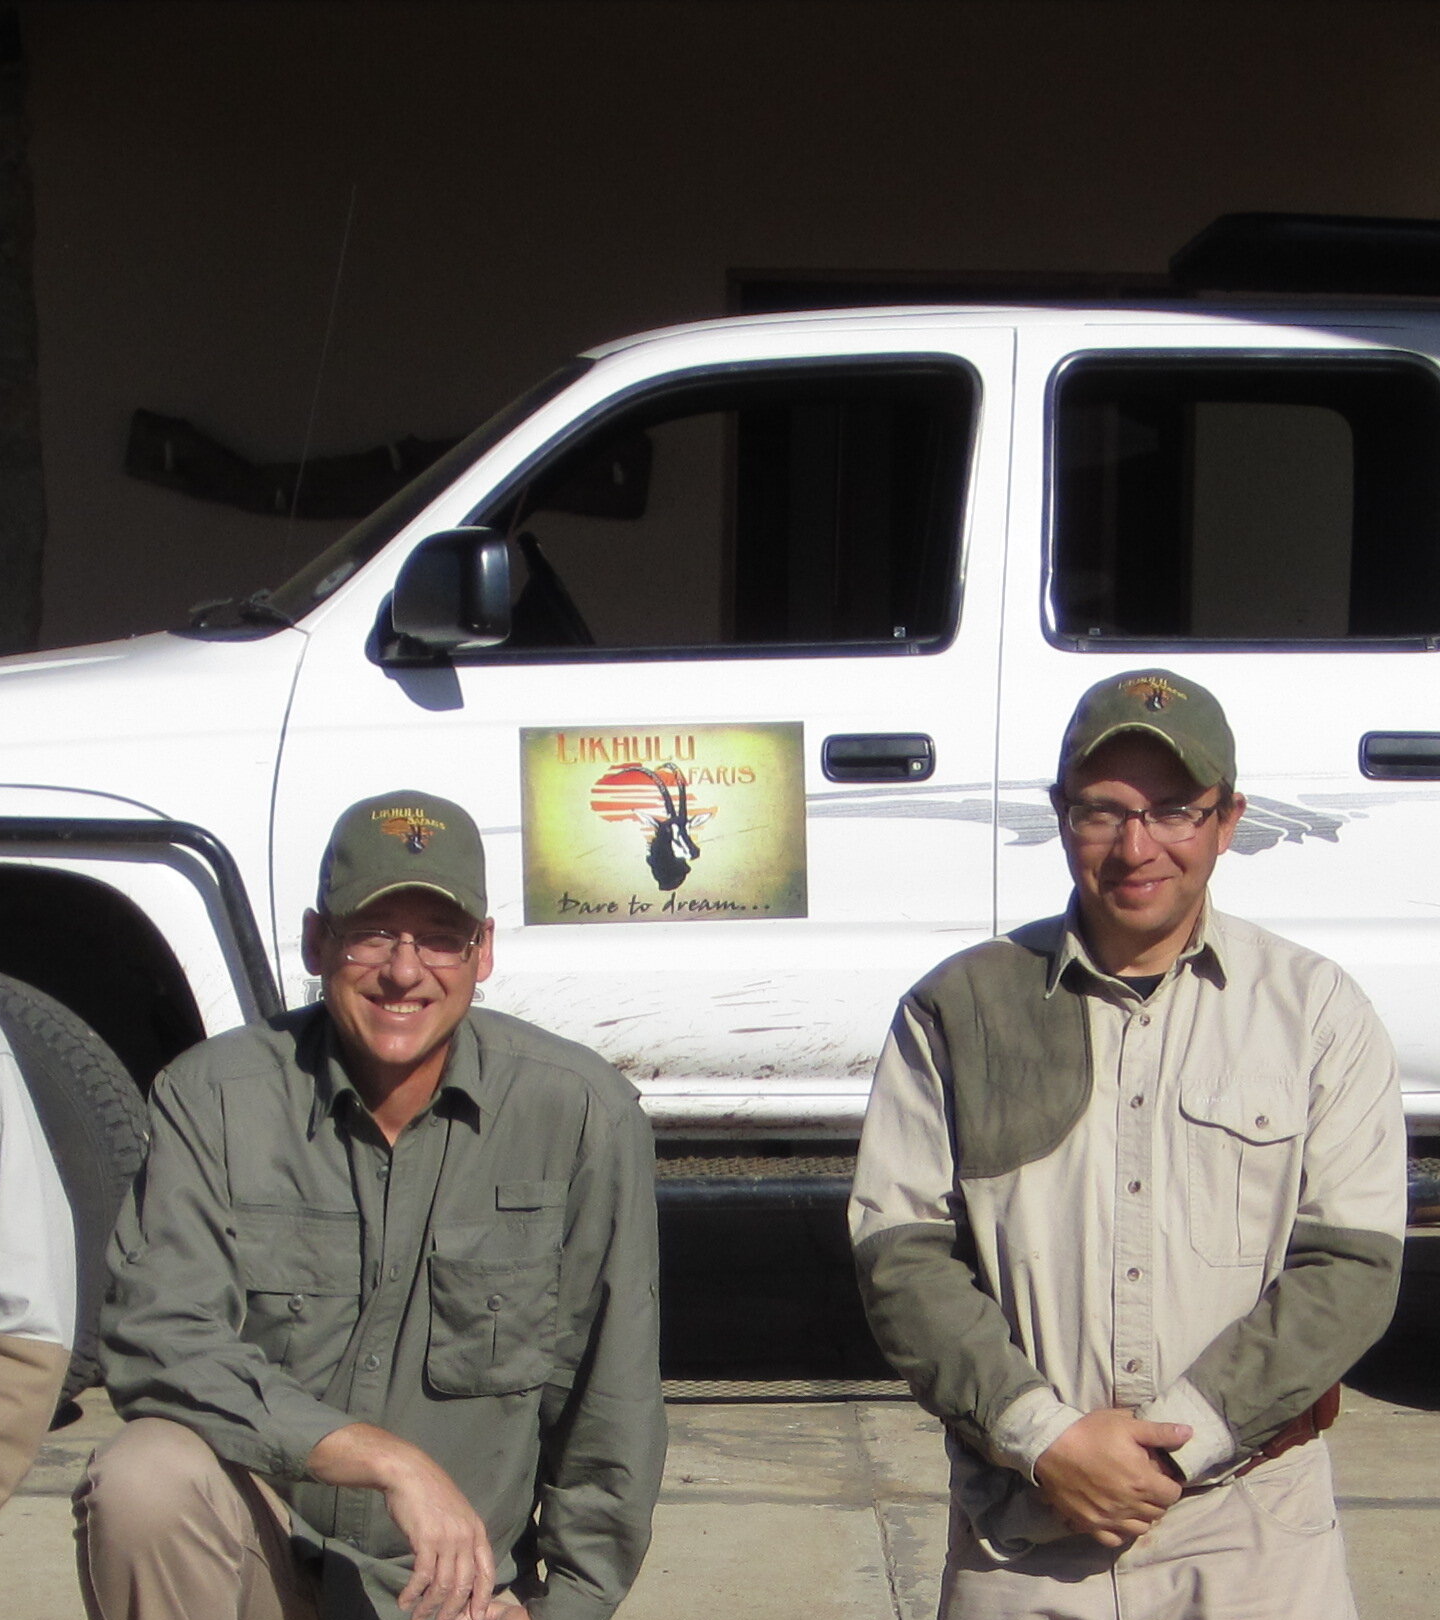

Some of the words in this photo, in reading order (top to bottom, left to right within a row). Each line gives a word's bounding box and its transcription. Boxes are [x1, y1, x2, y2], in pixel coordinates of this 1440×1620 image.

[556, 733, 695, 764] LIKHULU
[558, 891, 618, 915] Dare
[628, 894, 653, 916] to
[662, 891, 770, 915] dream...
